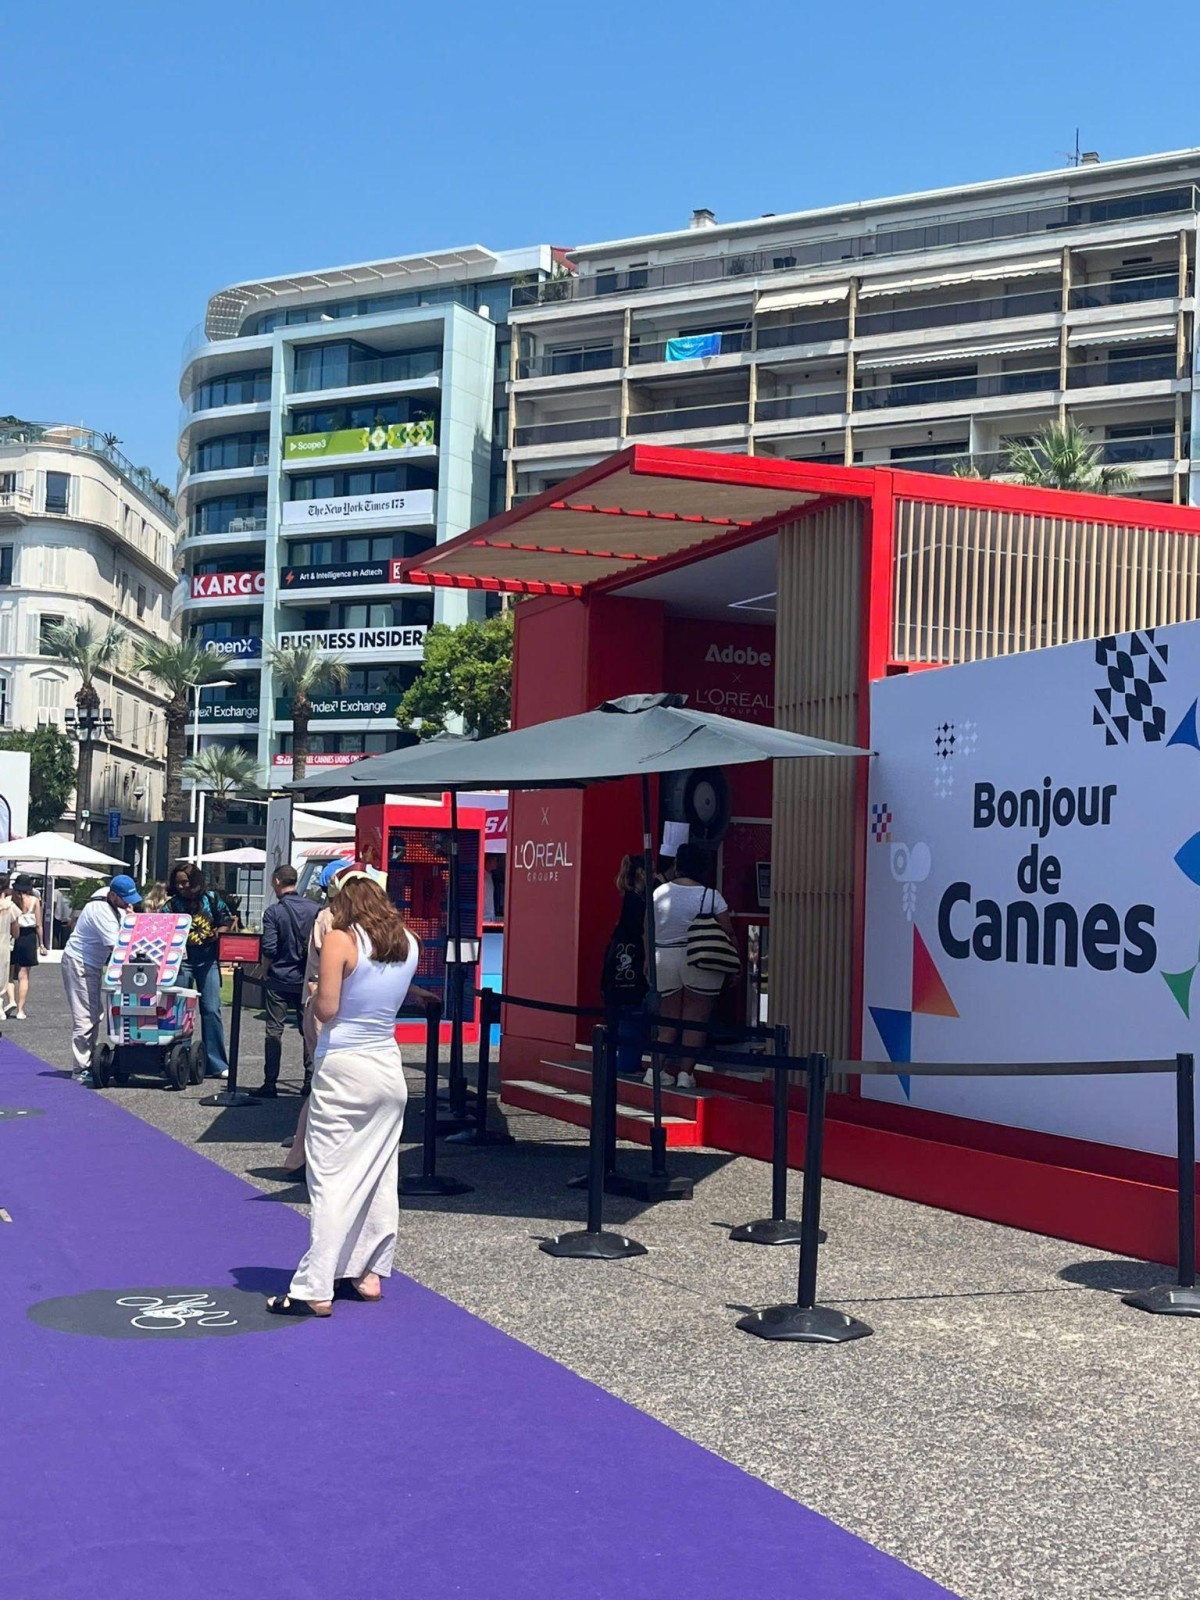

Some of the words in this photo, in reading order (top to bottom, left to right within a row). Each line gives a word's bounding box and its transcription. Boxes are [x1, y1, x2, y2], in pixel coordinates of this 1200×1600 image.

[298, 439, 326, 451] Scope3
[308, 505, 324, 517] The
[325, 504, 342, 514] New
[343, 502, 364, 515] York
[364, 500, 390, 511] Times
[316, 571, 351, 580] Intelligence
[360, 568, 383, 577] Adtech
[194, 573, 265, 596] KARGO
[205, 639, 254, 656] OpenX
[281, 633, 356, 650] BUSINESS
[360, 630, 423, 648] INSIDER
[705, 644, 771, 666] Adobe
[214, 706, 258, 718] Exchange
[340, 701, 387, 714] Exchange
[973, 776, 1117, 838] Bonjour
[1017, 843, 1061, 895] de
[938, 881, 1158, 974] Cannes
